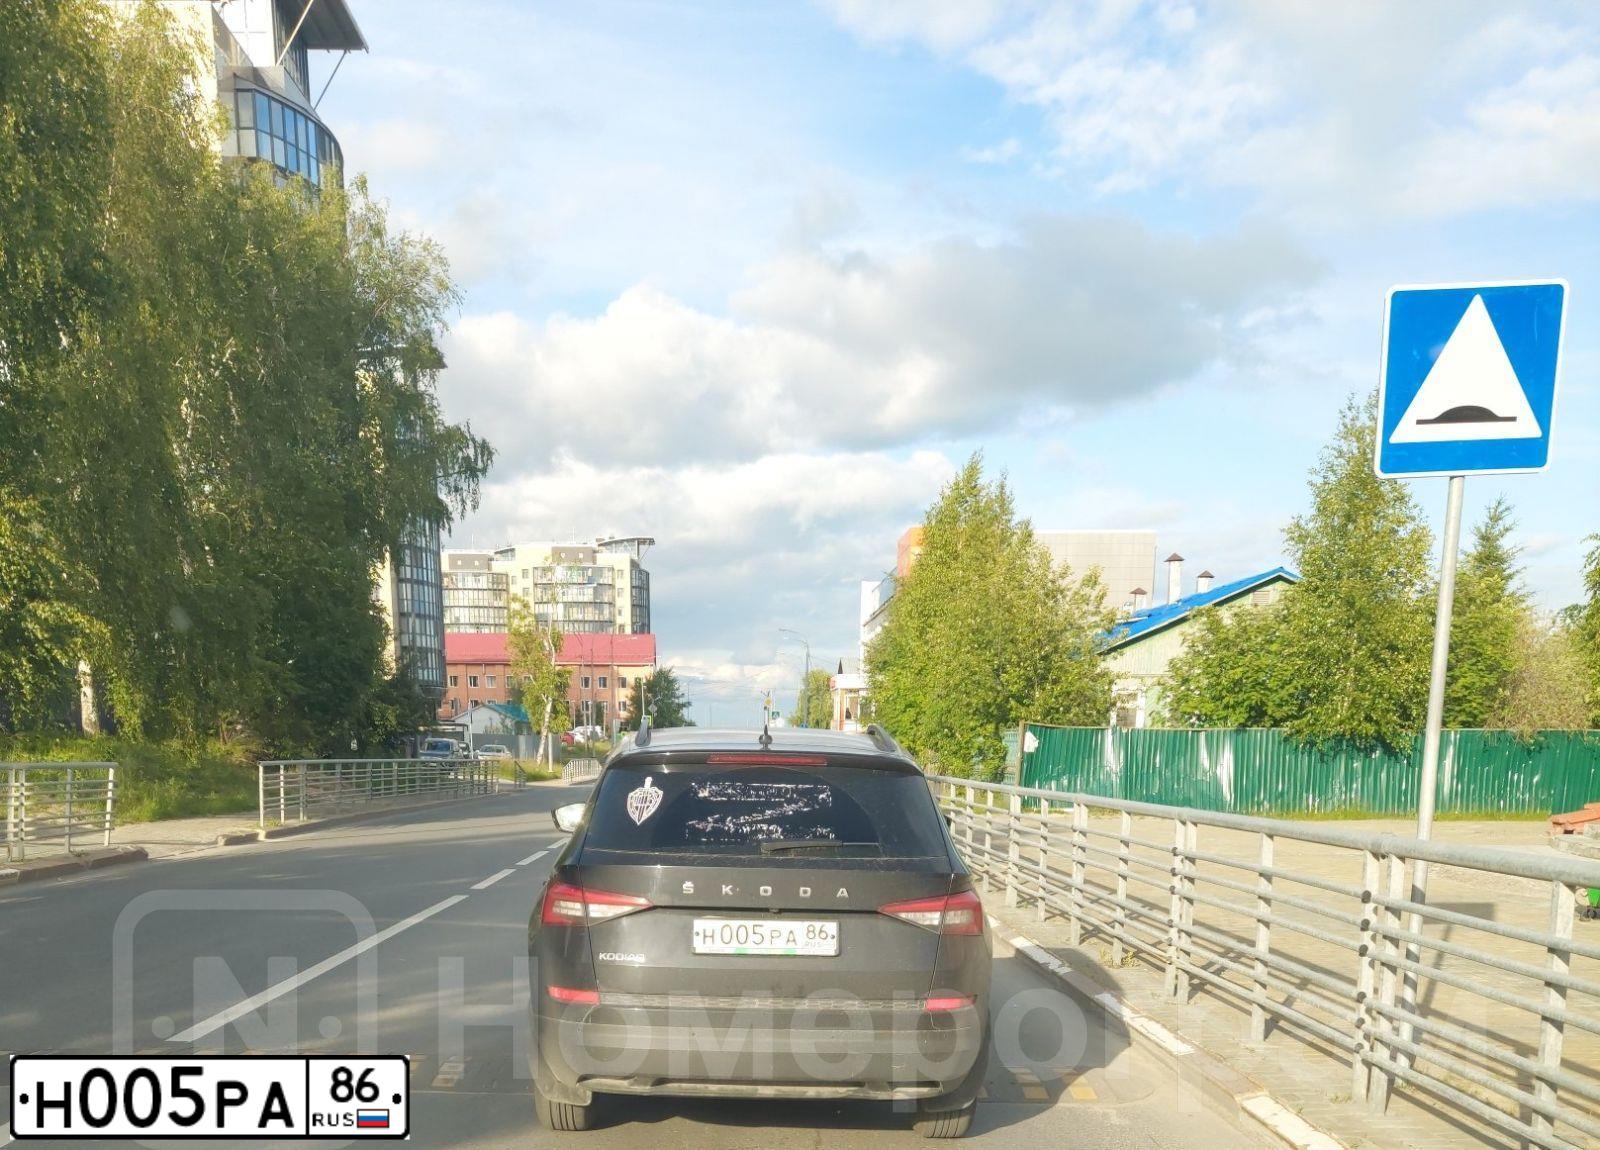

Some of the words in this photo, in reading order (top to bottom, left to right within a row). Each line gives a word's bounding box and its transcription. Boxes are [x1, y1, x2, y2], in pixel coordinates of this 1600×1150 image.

[682, 881, 849, 898] ŠKODA
[702, 924, 797, 945] Н005РА
[806, 924, 829, 940] 86
